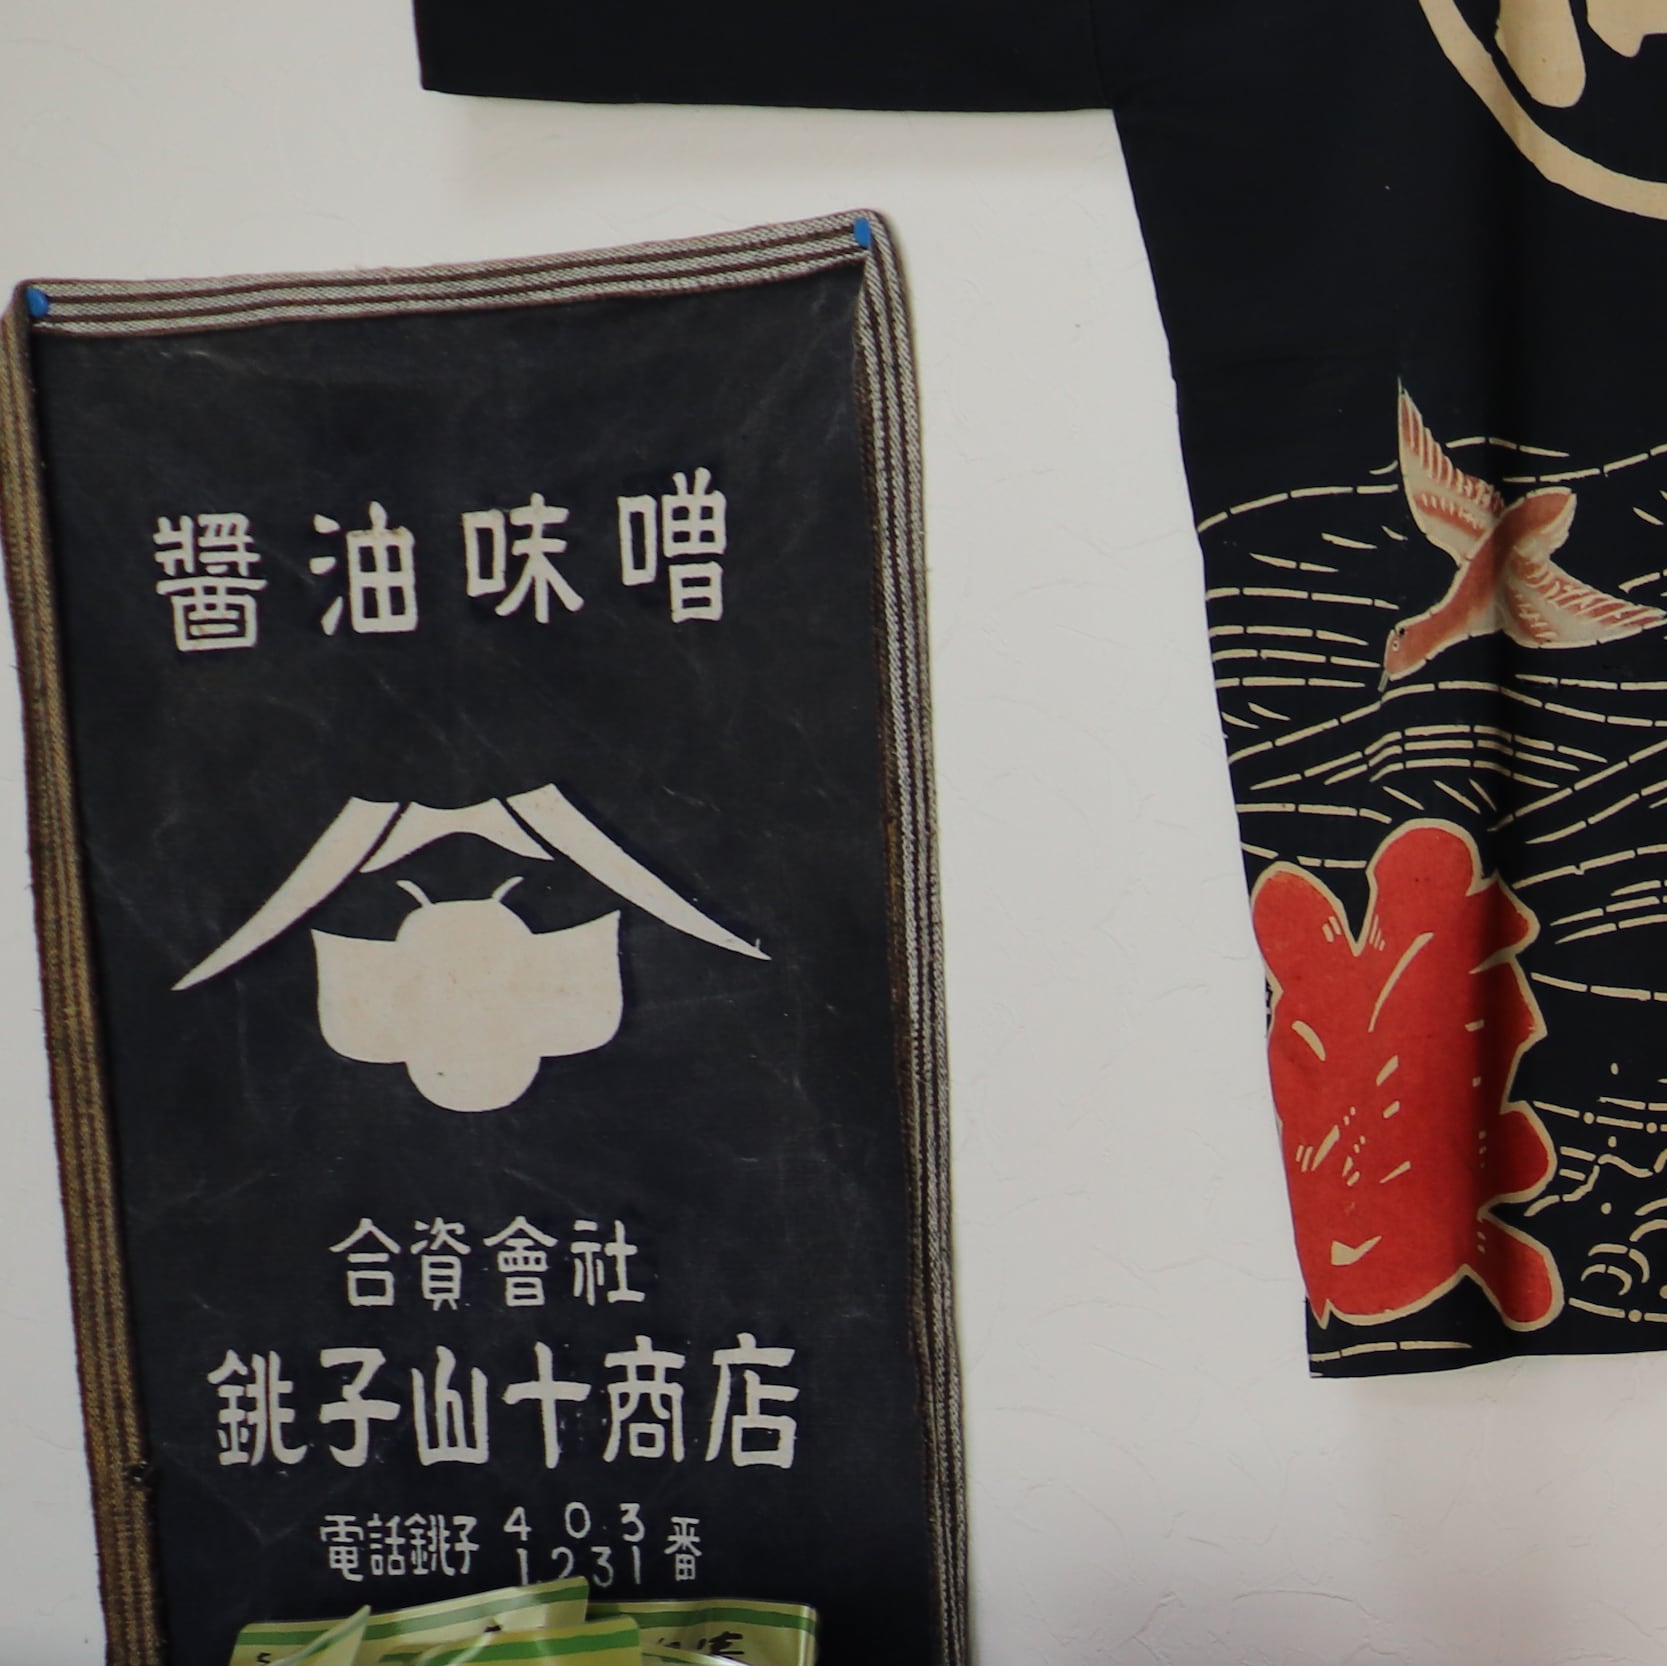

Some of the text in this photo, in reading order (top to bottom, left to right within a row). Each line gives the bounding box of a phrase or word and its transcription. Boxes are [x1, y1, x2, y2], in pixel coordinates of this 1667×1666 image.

[329, 1215, 646, 1311] 合資會社
[207, 1332, 801, 1470] 銚子山十商店
[320, 1513, 478, 1581] 電話銚子
[663, 1515, 704, 1582] 番
